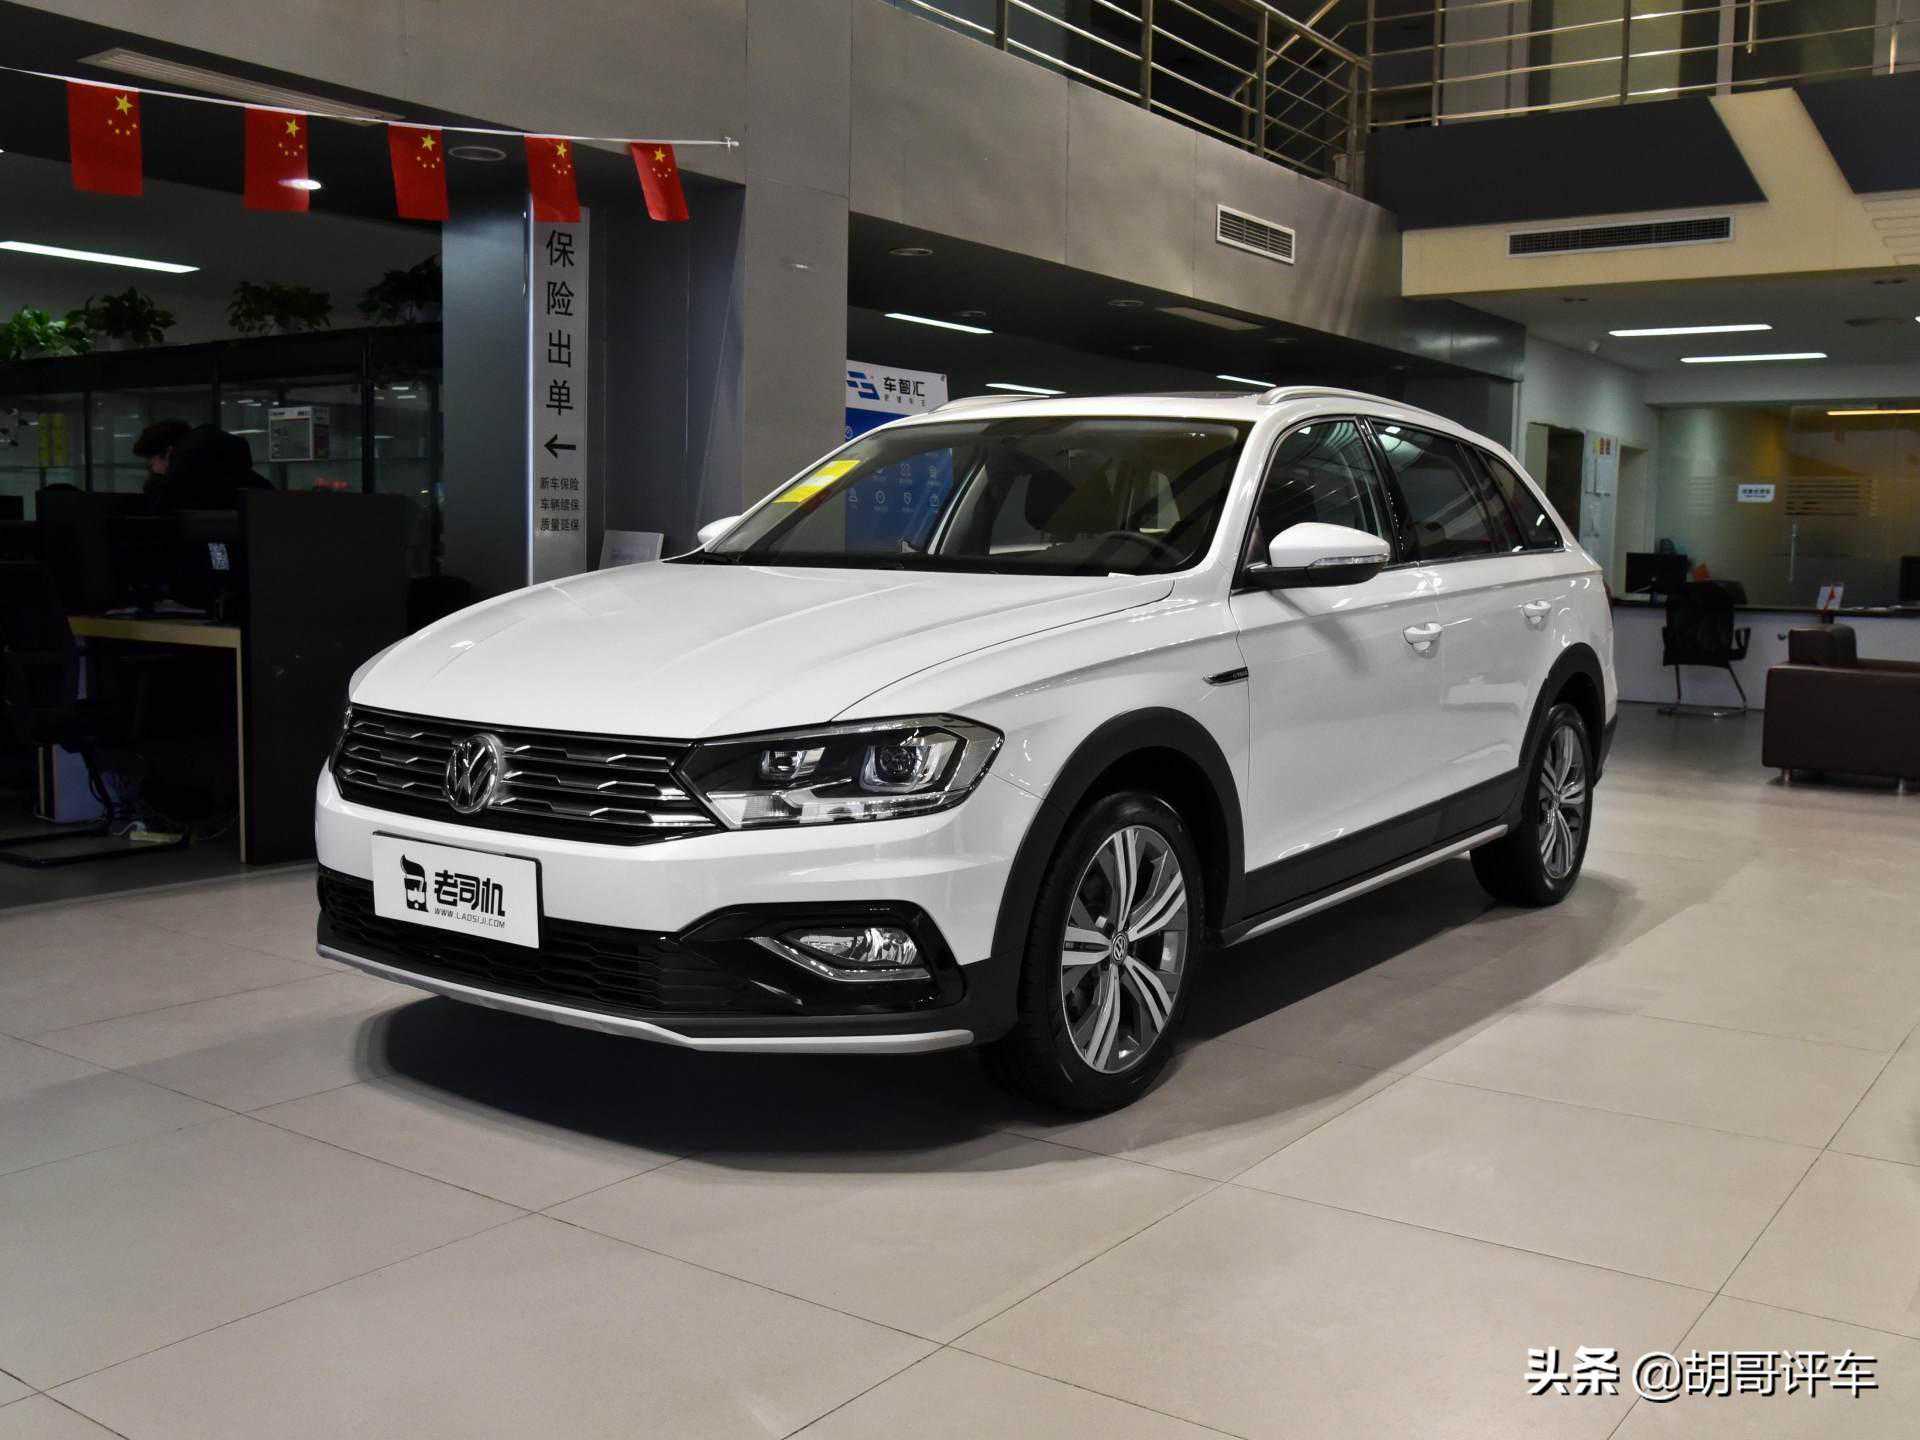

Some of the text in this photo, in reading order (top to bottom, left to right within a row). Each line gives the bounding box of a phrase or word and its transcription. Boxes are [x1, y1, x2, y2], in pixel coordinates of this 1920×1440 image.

[545, 229, 575, 416] 保险出单
[540, 477, 580, 491] 新车保险
[434, 869, 506, 918] 老司机
[434, 907, 506, 929] WWW.LAOSIJI.COM
